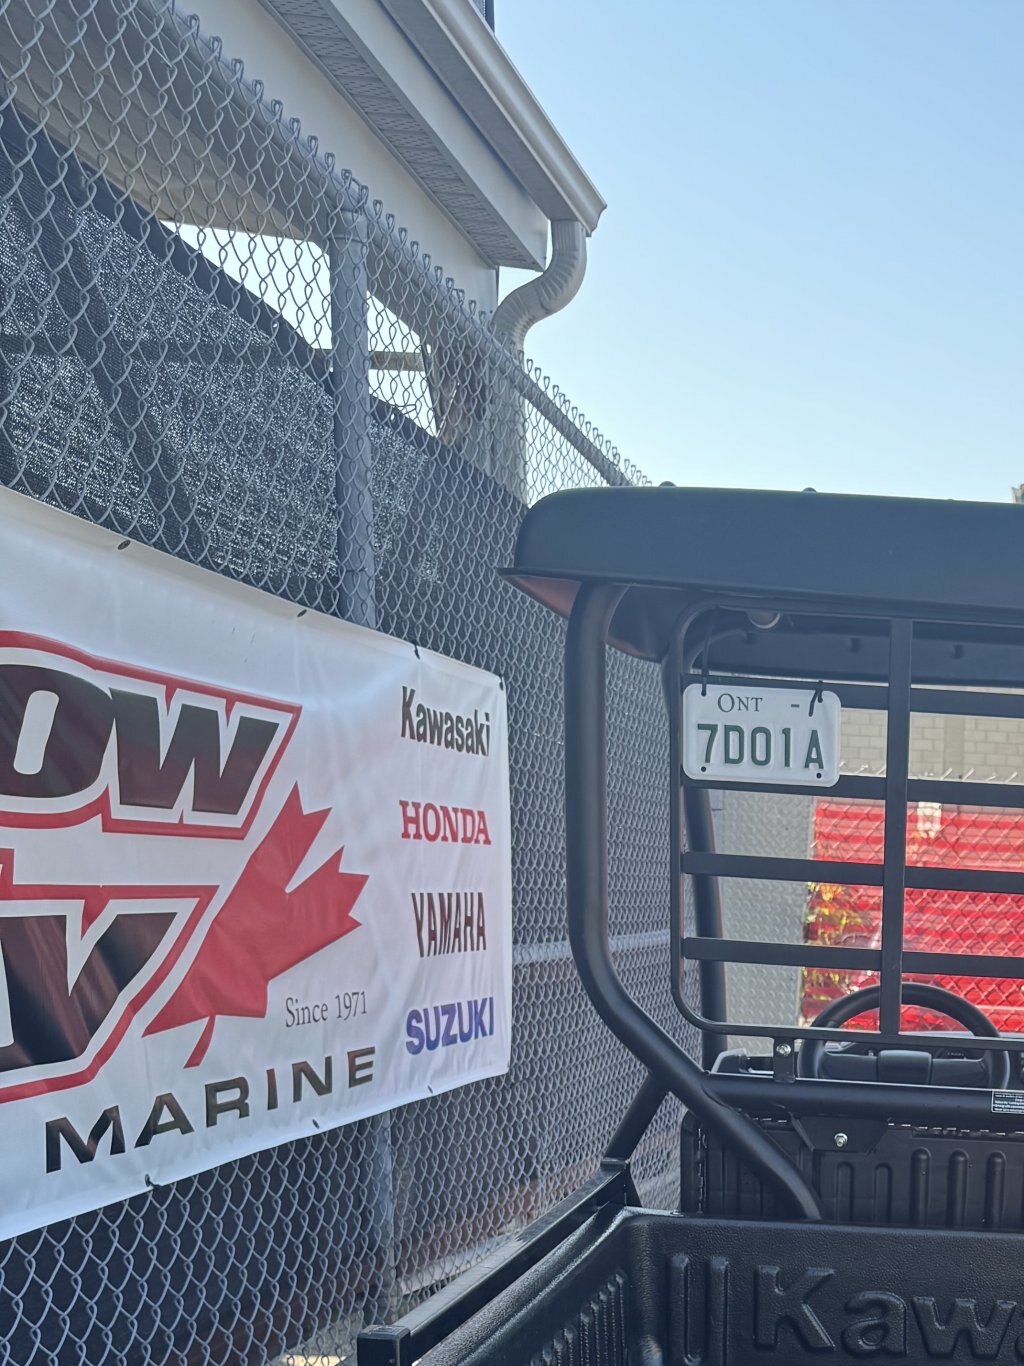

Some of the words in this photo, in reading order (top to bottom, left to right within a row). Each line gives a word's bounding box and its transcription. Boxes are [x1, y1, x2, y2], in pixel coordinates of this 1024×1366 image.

[401, 686, 490, 756] Kawasaki
[697, 723, 824, 770] 7D01A
[399, 800, 491, 845] HONDA
[411, 892, 486, 958] YAMAHA
[285, 997, 328, 1028] Since
[335, 991, 367, 1019] 1971
[406, 997, 494, 1055] SUZUKI
[46, 1047, 375, 1173] MARINE
